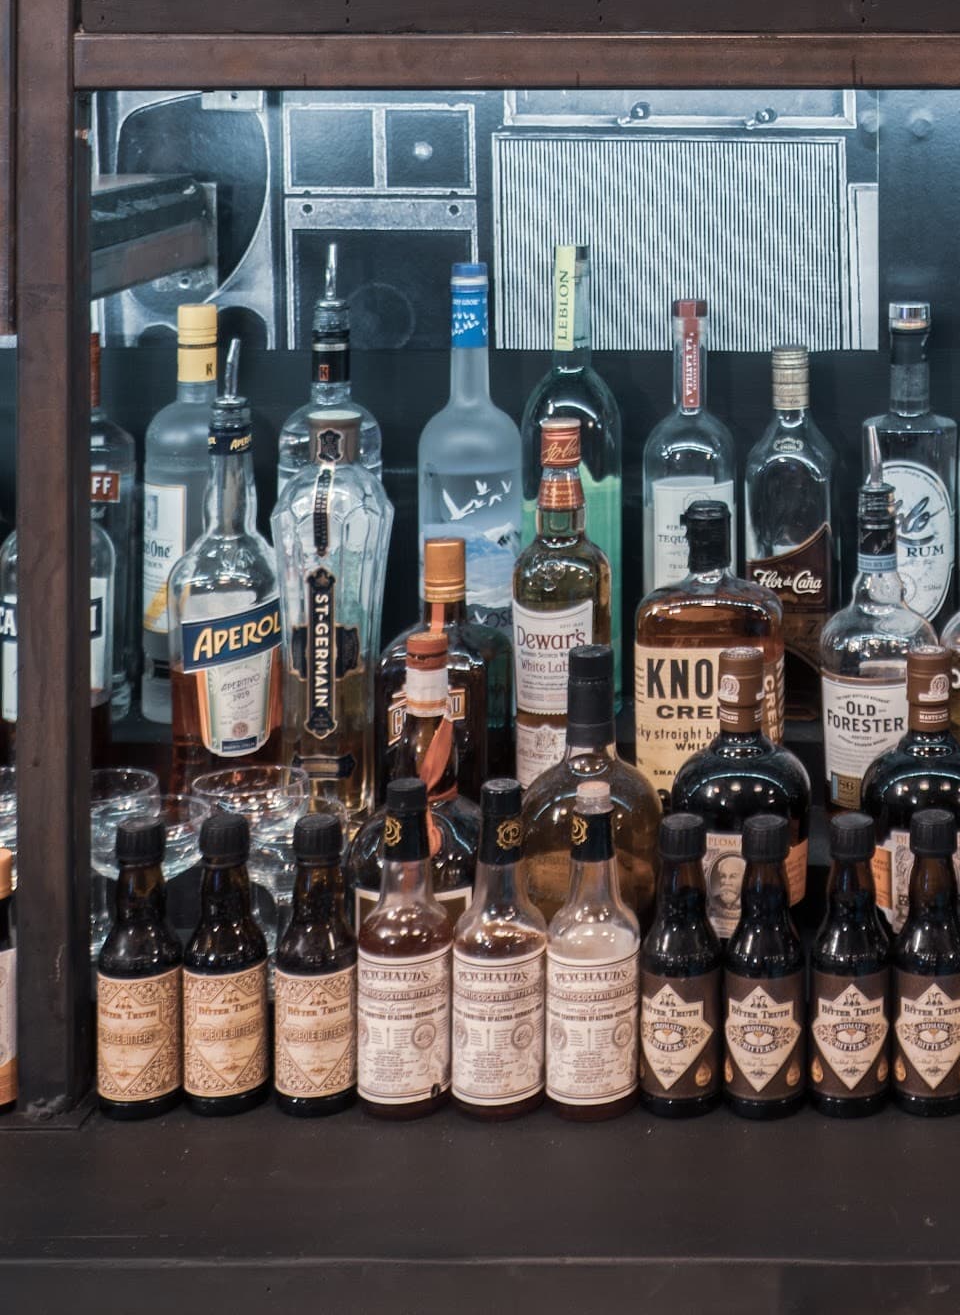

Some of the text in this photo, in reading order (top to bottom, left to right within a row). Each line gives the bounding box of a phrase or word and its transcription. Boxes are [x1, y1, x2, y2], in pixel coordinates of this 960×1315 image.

[557, 270, 569, 341] LEBLON
[205, 364, 213, 376] K
[151, 541, 171, 558] One
[906, 543, 945, 558] RUM
[753, 570, 783, 588] Flor
[792, 570, 822, 593] Caña
[192, 610, 281, 661] APEROL
[517, 625, 585, 650] Dewar's
[314, 593, 329, 708] ST-GERMAIN
[521, 662, 546, 674] White
[220, 673, 261, 693] APERITIVO
[647, 658, 714, 700] KNO
[233, 689, 250, 702] 1919
[656, 705, 720, 719] CRE
[846, 700, 876, 717] OLD
[827, 709, 904, 733] FORESTER
[654, 726, 704, 741] straight
[361, 970, 431, 982] PEYCHAUD'S
[457, 971, 529, 983] PEYCHAUD'S
[554, 971, 630, 983] PEYCHAUD'S
[125, 1010, 157, 1019] TRUTH
[199, 1000, 261, 1016] BITTER TRUTH
[288, 1002, 349, 1016] BITTER TRUTH
[670, 1008, 700, 1018] TRUTH
[731, 1004, 790, 1019] BITTER TRUTH
[821, 1004, 881, 1017] BITTER TRUTH
[904, 1003, 933, 1017] BITTER
